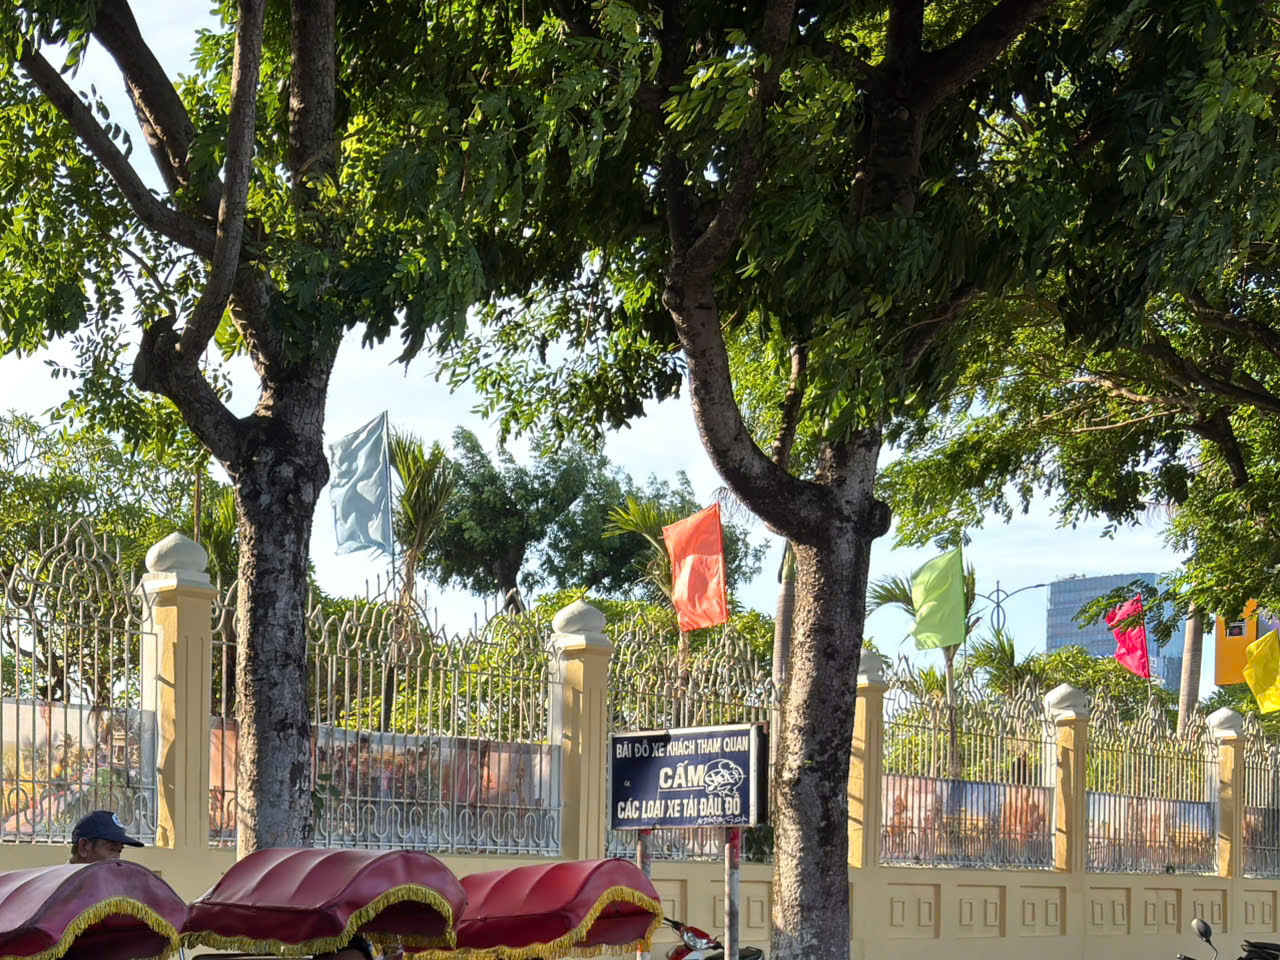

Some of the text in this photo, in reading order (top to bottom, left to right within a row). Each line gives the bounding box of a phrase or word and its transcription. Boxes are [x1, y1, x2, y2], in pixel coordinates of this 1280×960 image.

[616, 741, 632, 758] BÃI
[651, 742, 665, 757] XE
[666, 738, 695, 756] KHÁCH
[697, 738, 721, 754] THAM
[723, 736, 748, 752] QUAN
[659, 760, 705, 788] CẤM
[617, 798, 639, 819] CÁC
[641, 799, 664, 820] LOẠI
[666, 799, 680, 818] XE
